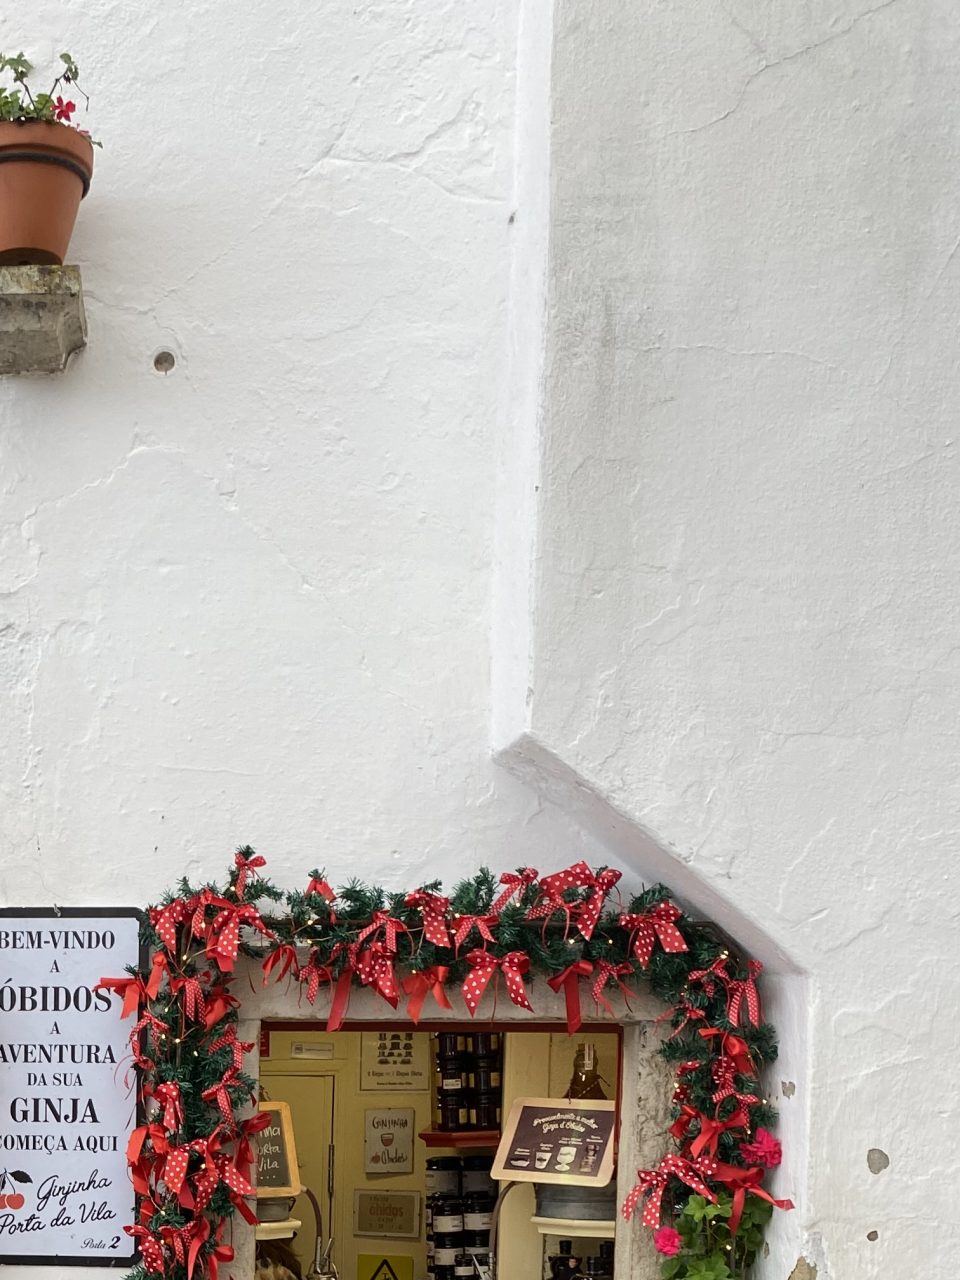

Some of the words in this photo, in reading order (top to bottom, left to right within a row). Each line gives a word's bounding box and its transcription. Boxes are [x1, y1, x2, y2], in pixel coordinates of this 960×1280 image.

[50, 959, 60, 973] A
[50, 1021, 61, 1035] A
[27, 1072, 48, 1087] DA
[52, 1072, 83, 1087] SUA
[10, 1097, 100, 1123] GINJA
[74, 1135, 119, 1153] AQUI
[36, 1169, 113, 1212] Ginjinha
[50, 1207, 76, 1228] da
[79, 1201, 117, 1224] Vila
[108, 1236, 122, 1250] 2
